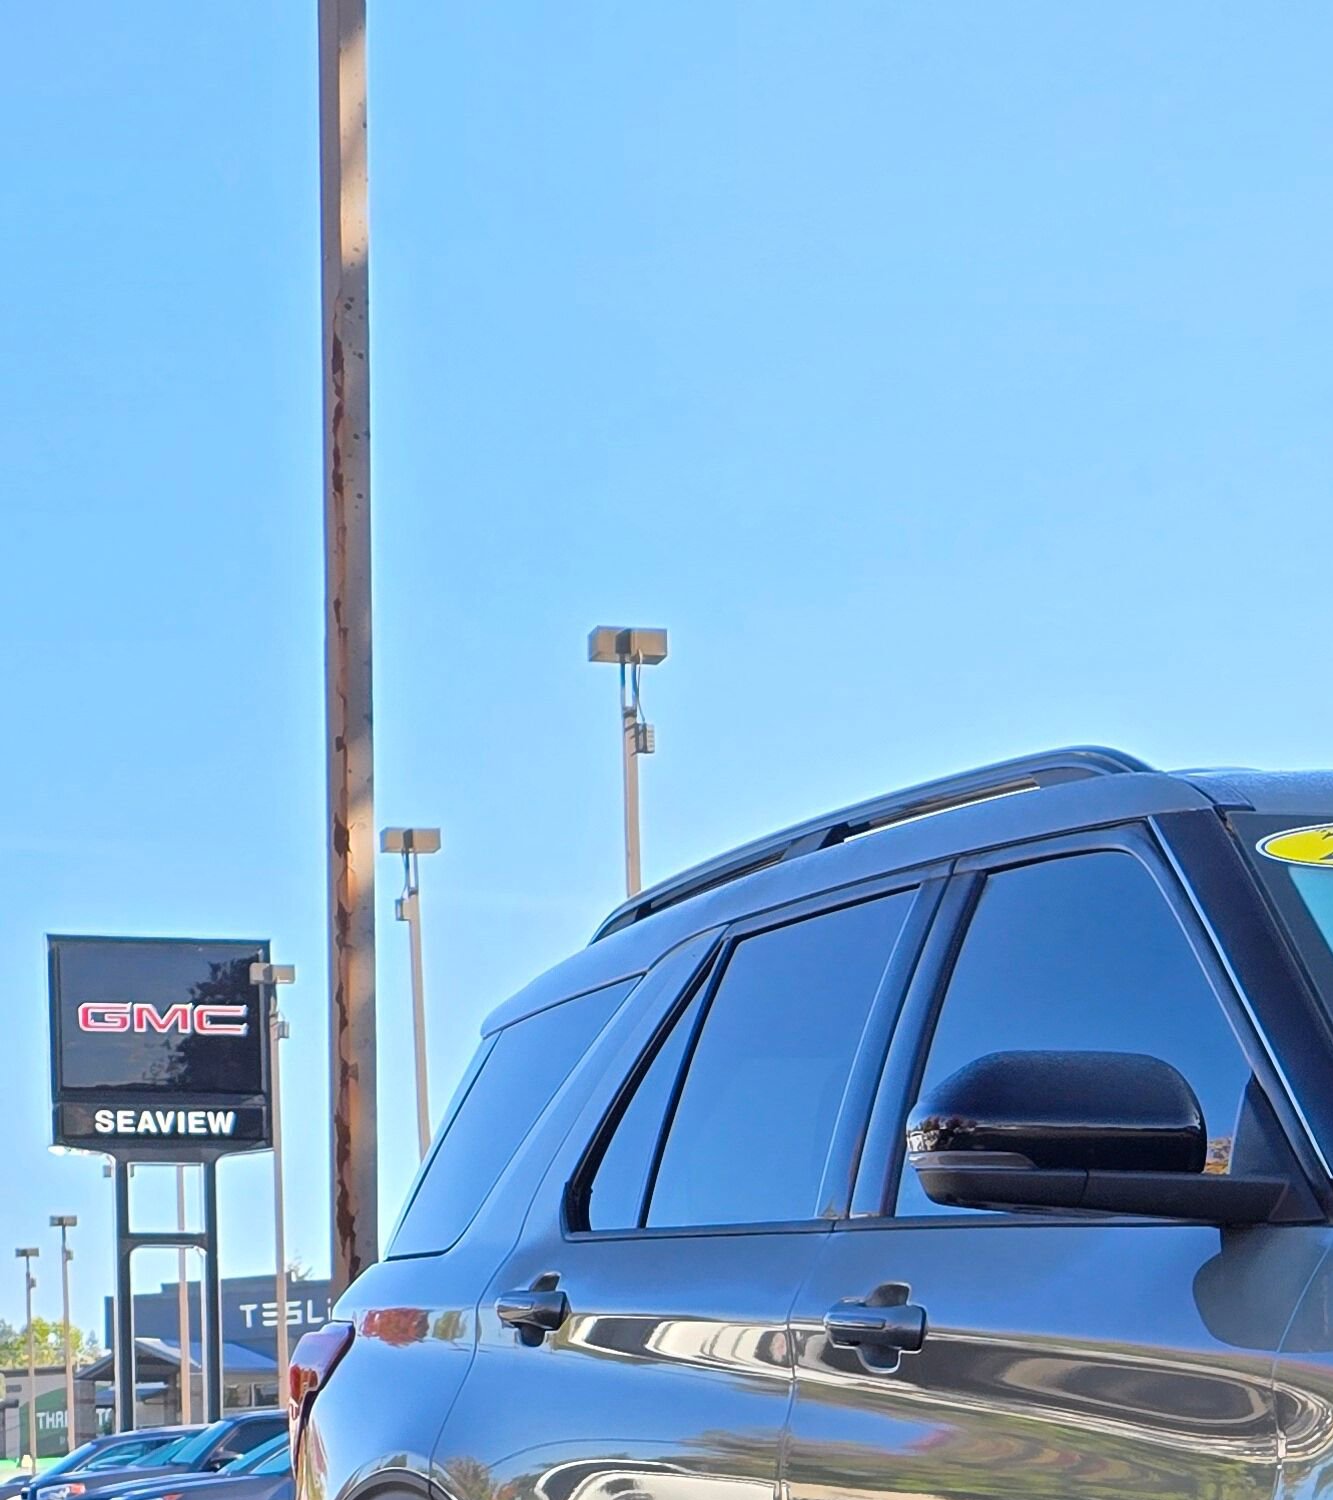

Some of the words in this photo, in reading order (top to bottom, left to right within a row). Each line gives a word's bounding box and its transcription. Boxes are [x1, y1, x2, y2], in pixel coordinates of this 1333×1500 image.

[77, 1001, 250, 1036] GMC
[94, 1109, 236, 1135] SEAVIEW
[239, 1298, 333, 1329] TESL
